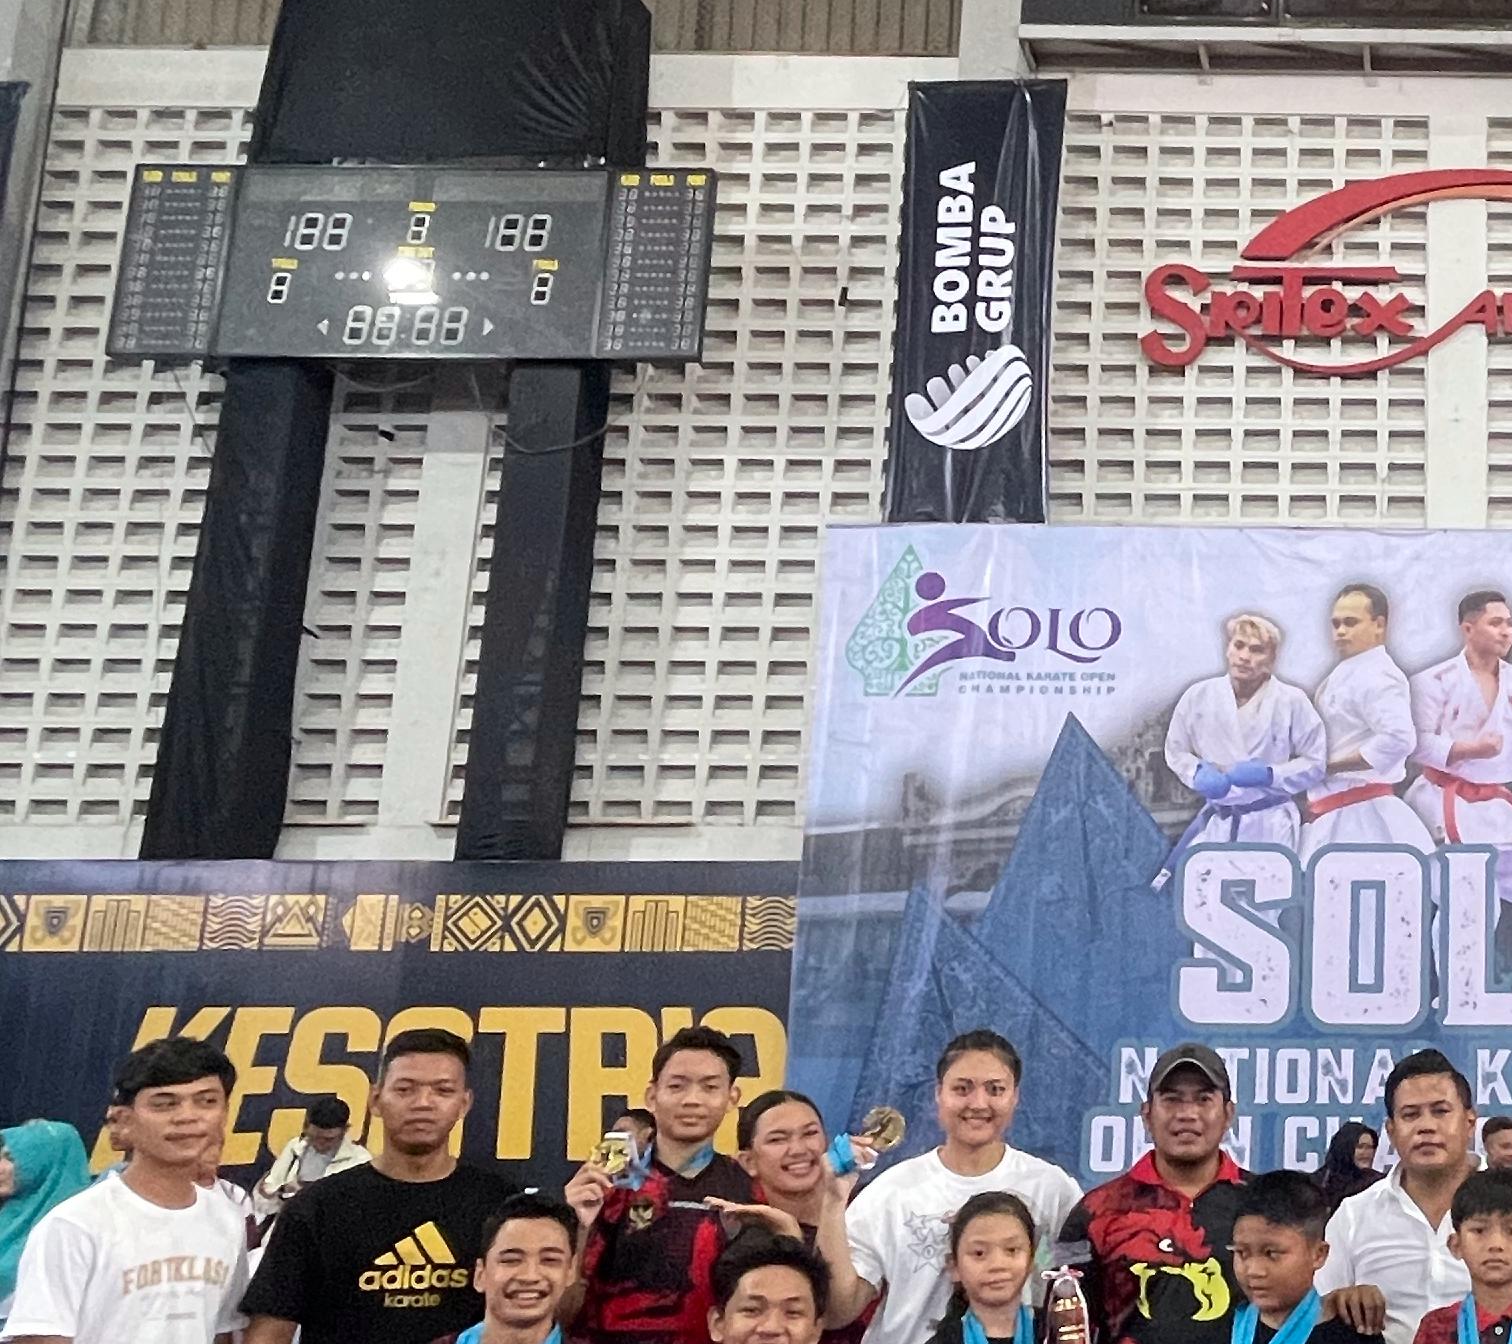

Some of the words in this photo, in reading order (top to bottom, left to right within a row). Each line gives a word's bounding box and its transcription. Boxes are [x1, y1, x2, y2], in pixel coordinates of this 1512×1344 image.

[931, 161, 977, 334] BOMBA
[974, 205, 1017, 334] GRUP
[958, 683, 1116, 695] CHAMPIONSHIP
[959, 671, 1021, 682] NATIONAL
[1026, 671, 1076, 682] KARATE
[1080, 672, 1116, 682] OPEN
[1118, 1046, 1425, 1105] NTIONA
[358, 1264, 469, 1291] adidas
[383, 1292, 442, 1308] karate
